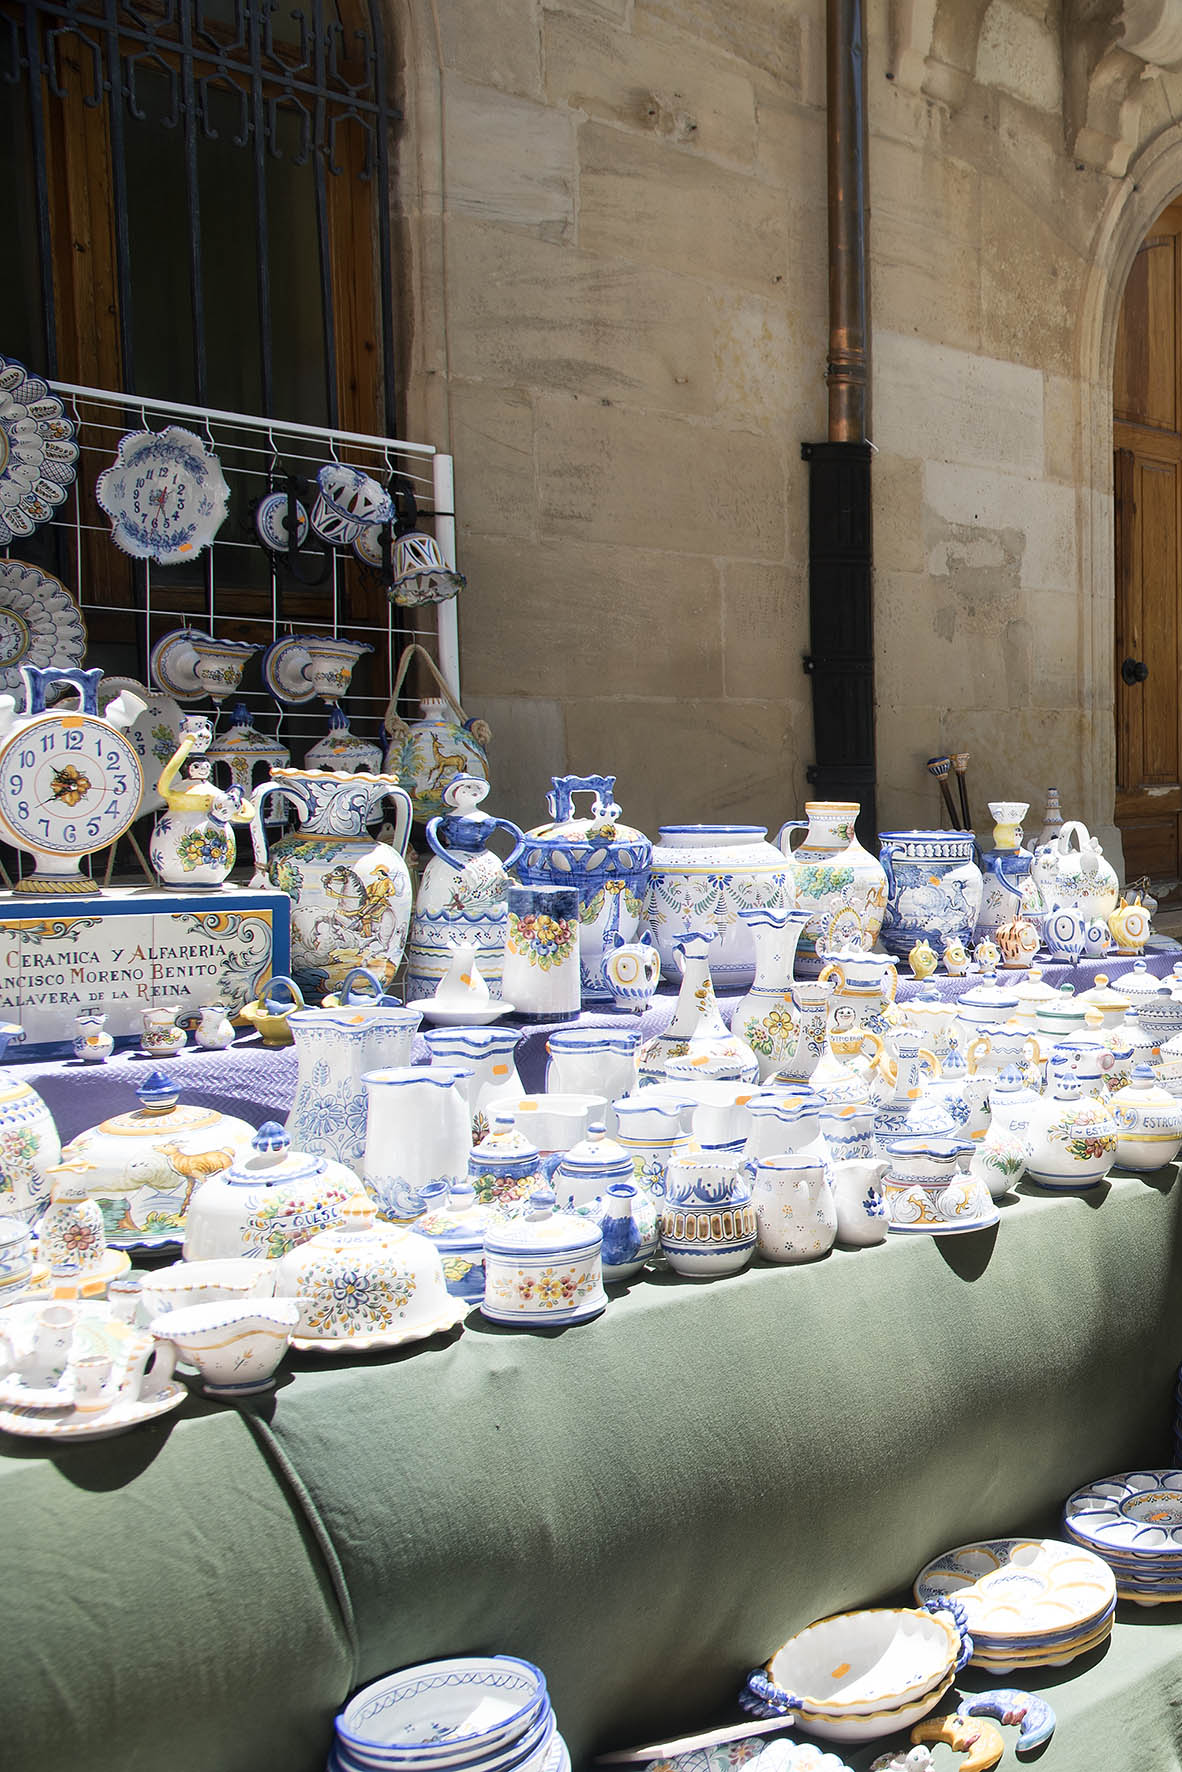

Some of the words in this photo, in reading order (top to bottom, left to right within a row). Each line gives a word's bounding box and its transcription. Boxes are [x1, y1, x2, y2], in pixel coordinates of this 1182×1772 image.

[145, 468, 154, 480] 11
[158, 467, 169, 478] 12
[172, 473, 178, 484] 1
[135, 478, 145, 488] 10
[177, 484, 185, 495] 2
[133, 489, 140, 500] 9
[177, 498, 185, 510] 3
[133, 501, 140, 513] 8
[141, 513, 148, 523] 7
[151, 518, 158, 528] 6
[163, 518, 170, 528] 5
[40, 733, 55, 752] 11
[62, 730, 85, 750] 12
[134, 731, 144, 742] 2
[95, 738, 102, 757] 1
[19, 750, 36, 769] 10
[106, 751, 121, 771] 2
[9, 775, 23, 796] 9
[113, 774, 127, 796] 3
[17, 801, 30, 820] 8
[104, 800, 120, 819] 4
[38, 818, 50, 837] 7
[63, 824, 77, 843] 6
[86, 816, 102, 836] 5
[6, 950, 100, 968] CERAMICA
[127, 944, 226, 965] ALFARERIA
[0, 974, 65, 990] NCISCO
[70, 966, 144, 985] MORENO
[149, 963, 217, 980] BENITO
[0, 991, 81, 1007] ALAVERA
[135, 983, 192, 1002] REINA
